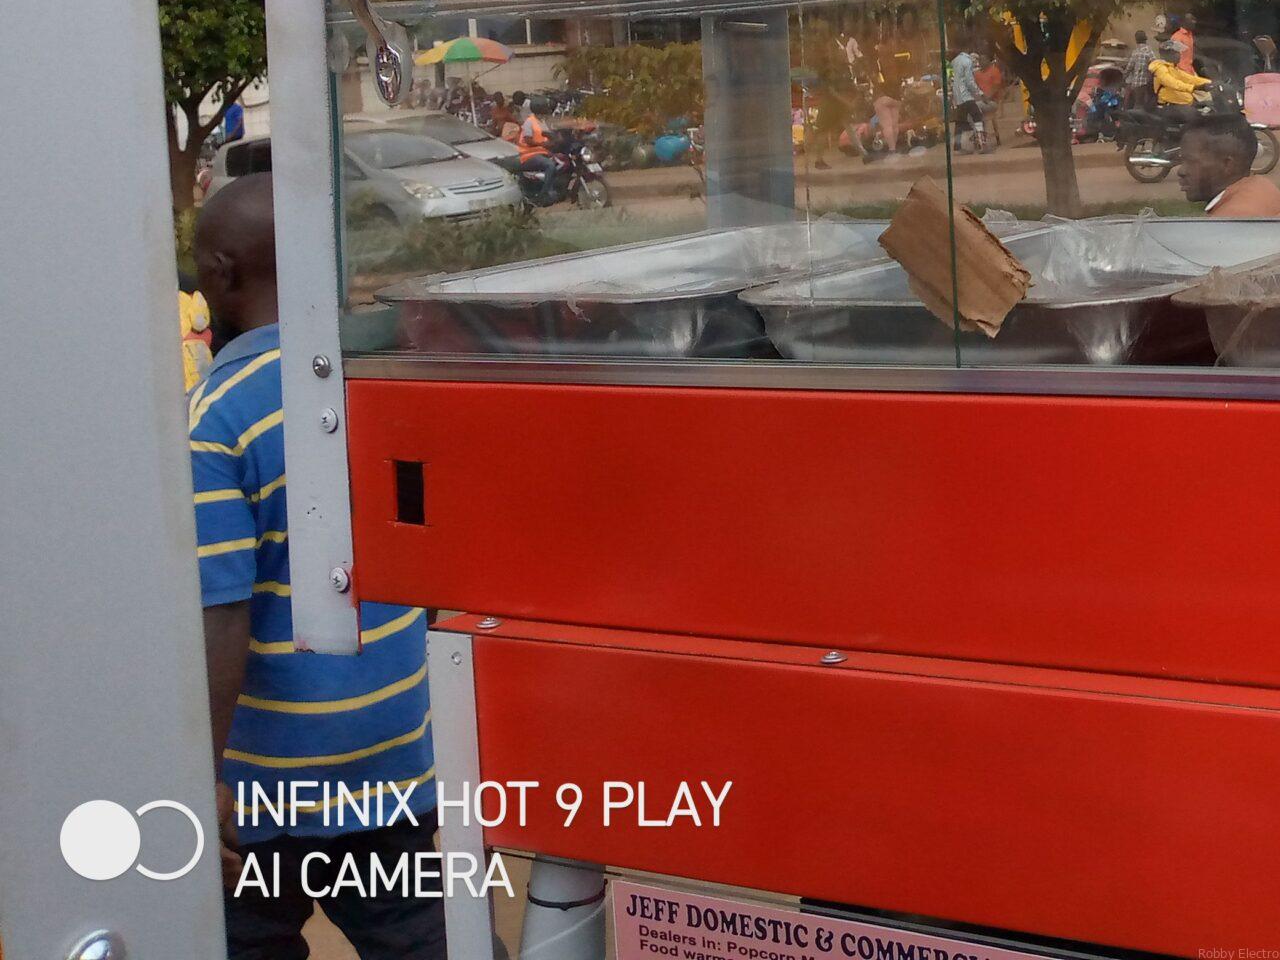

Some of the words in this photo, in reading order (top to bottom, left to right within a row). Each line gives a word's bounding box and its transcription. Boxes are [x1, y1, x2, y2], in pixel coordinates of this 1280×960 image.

[626, 894, 680, 924] JEFF
[686, 903, 809, 948] DOMESTIC
[815, 927, 834, 952] &
[639, 924, 697, 946] Dealers
[702, 936, 721, 951] in:
[640, 939, 679, 957] Food
